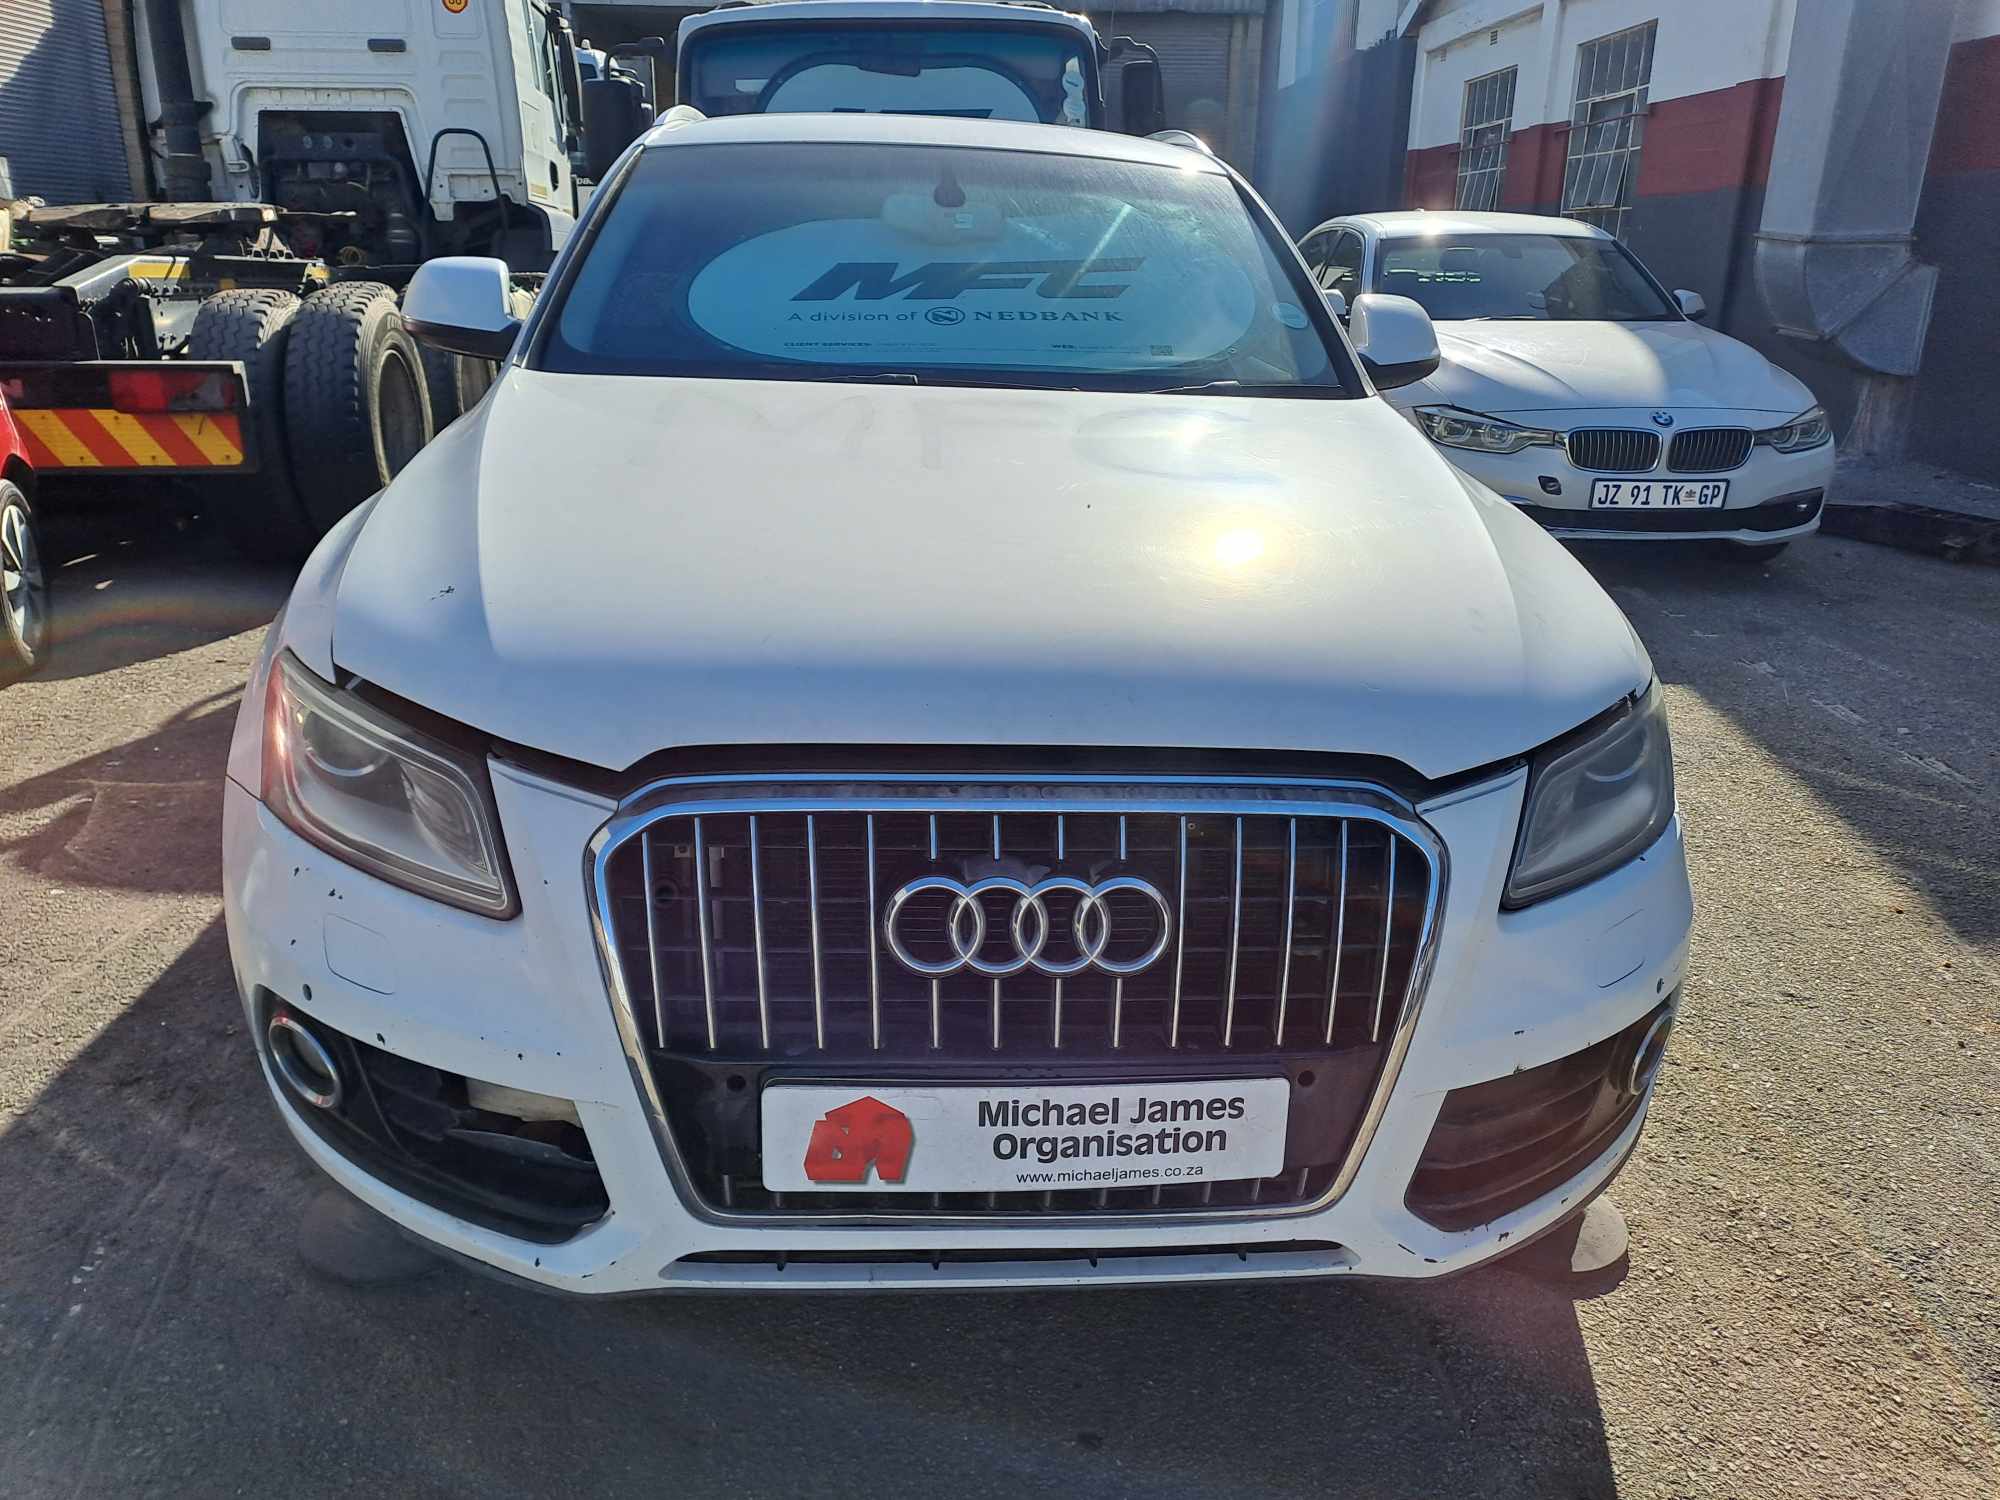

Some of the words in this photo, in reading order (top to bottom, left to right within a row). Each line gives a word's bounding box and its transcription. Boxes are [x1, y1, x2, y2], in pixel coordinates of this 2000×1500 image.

[789, 256, 1146, 301] MFC
[788, 311, 802, 321] A
[809, 311, 889, 322] division
[895, 311, 918, 321] of
[974, 311, 1125, 322] NEDBANK
[1597, 484, 1622, 505] JZ
[1630, 484, 1652, 505] 91
[1662, 484, 1685, 505] TK
[1697, 484, 1721, 505] GP
[978, 1097, 1120, 1128] Michael
[1129, 1096, 1245, 1124] James
[992, 1127, 1227, 1164] Organisation
[1016, 1165, 1204, 1184] www.michaeljames.co.za
